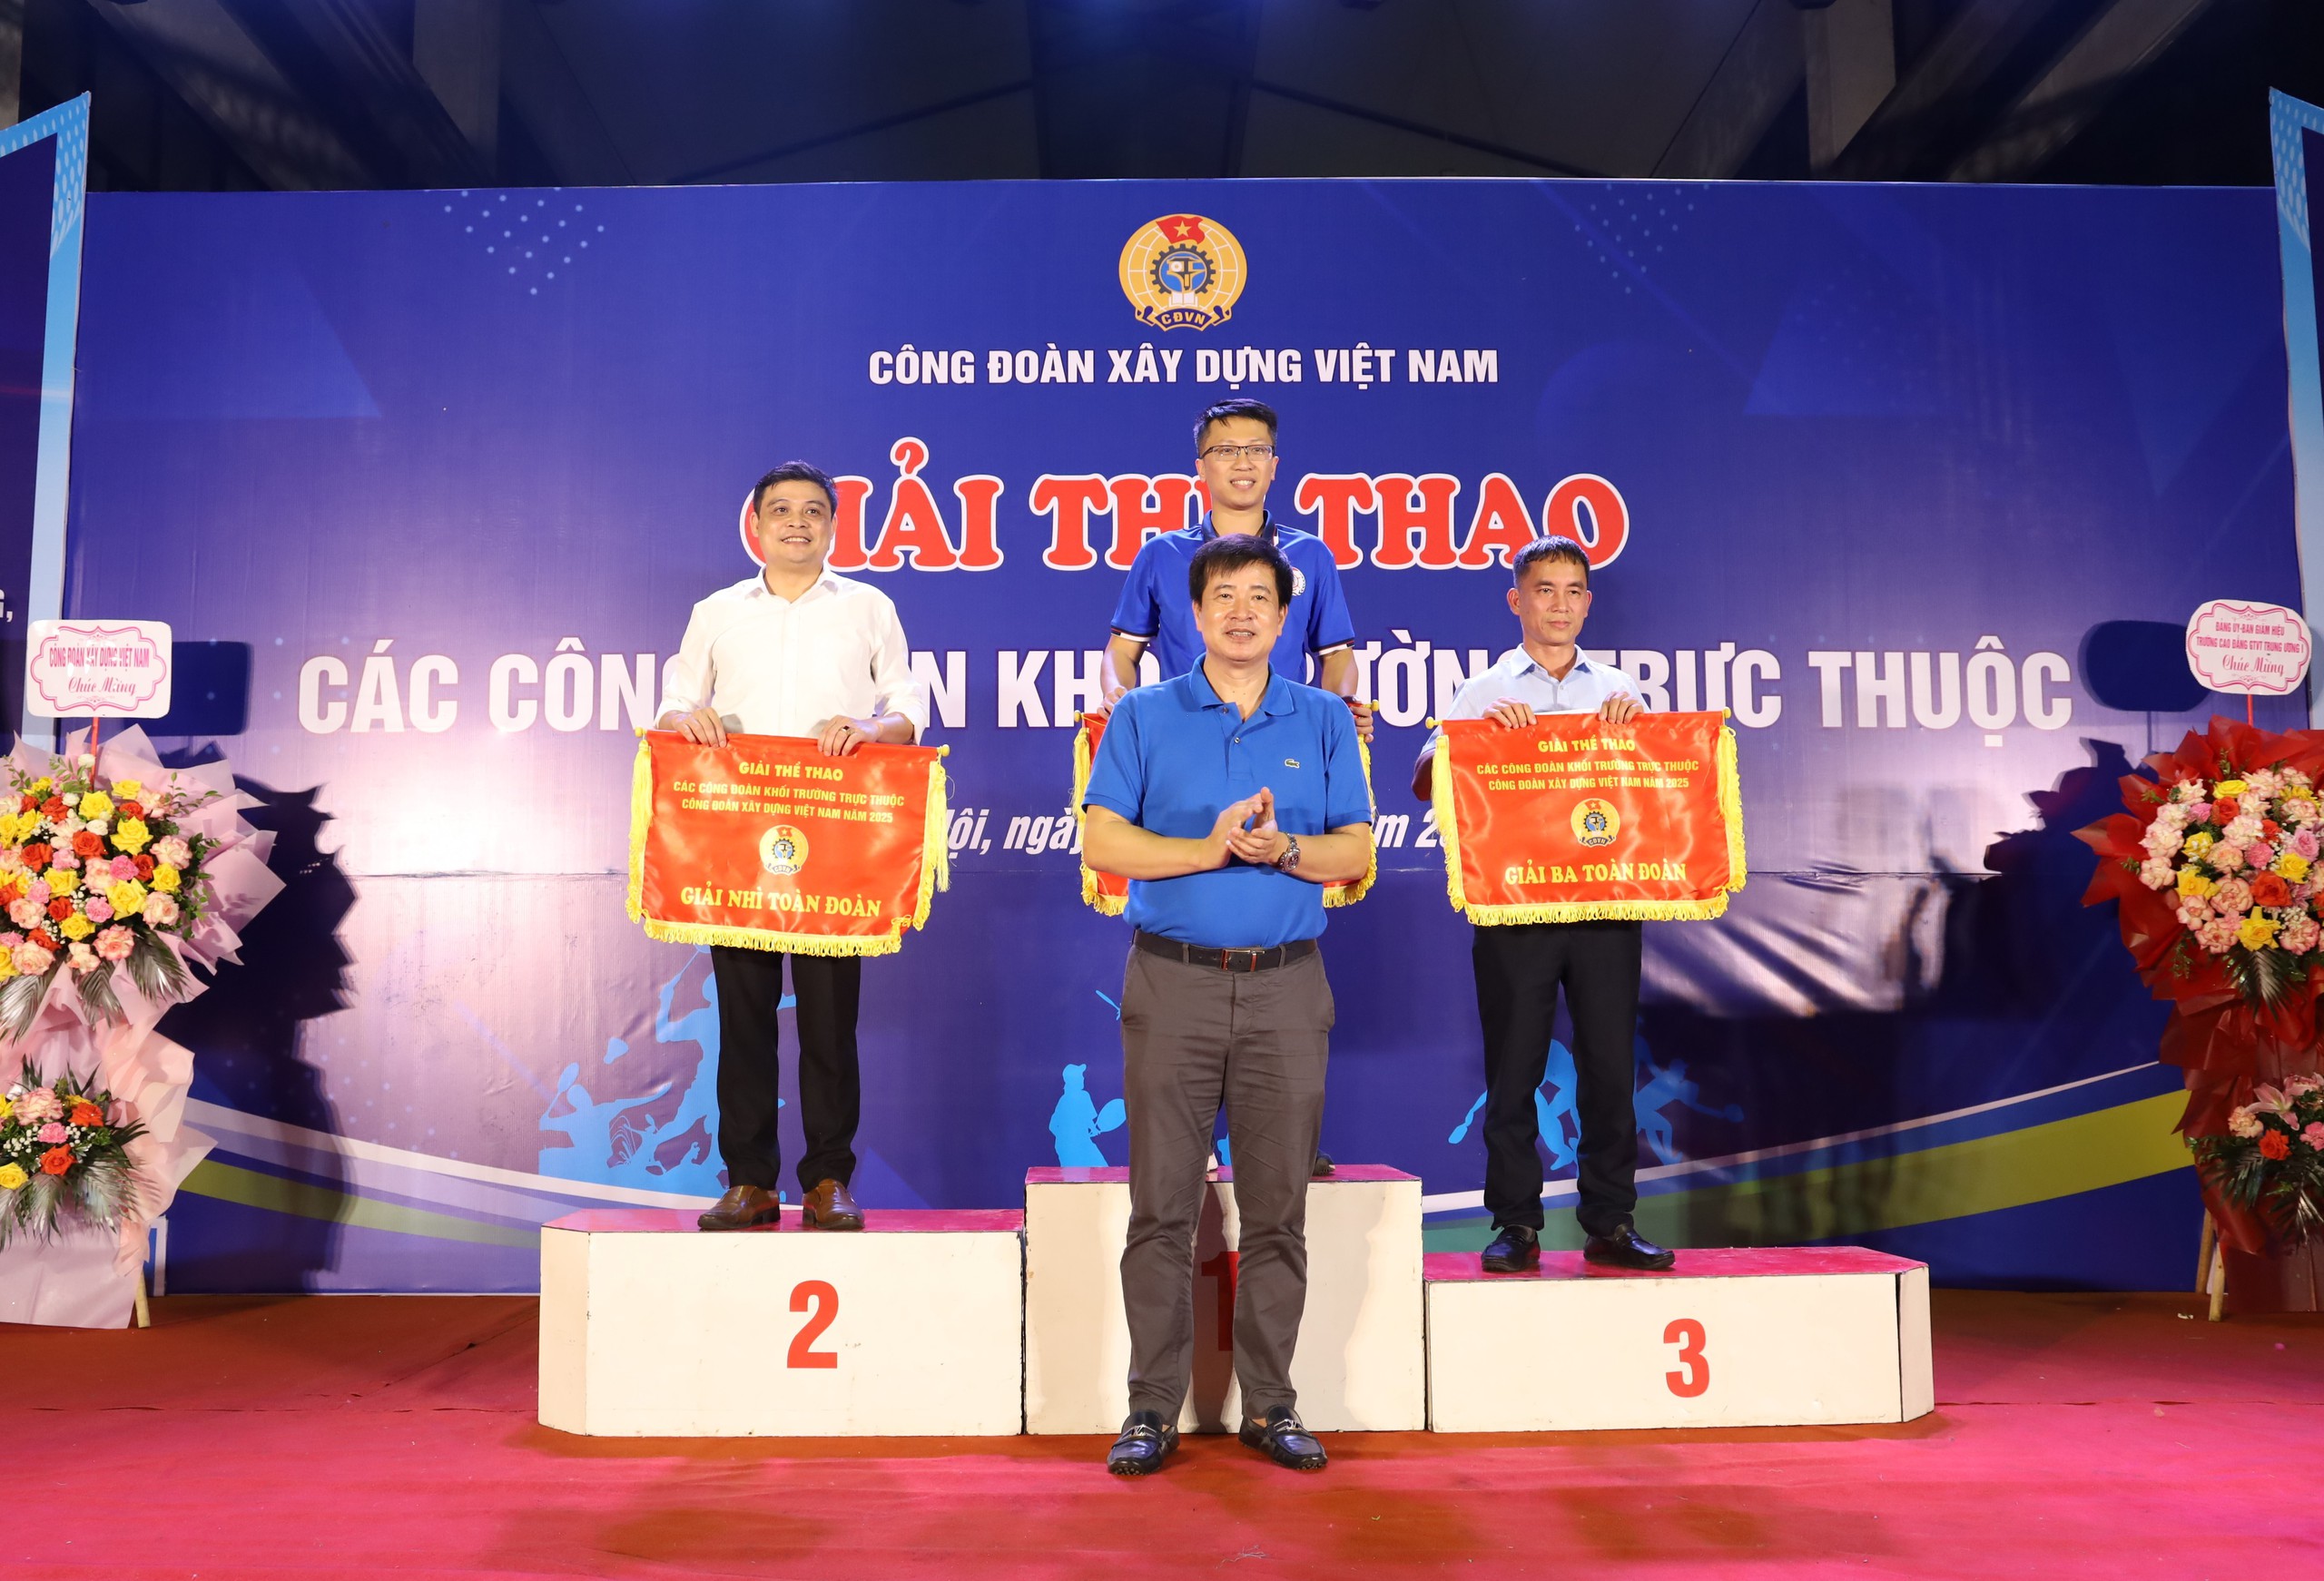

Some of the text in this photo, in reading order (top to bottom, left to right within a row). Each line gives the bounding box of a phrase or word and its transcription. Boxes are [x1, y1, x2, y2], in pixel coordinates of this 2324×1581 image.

[1161, 311, 1206, 325] CĐVN
[869, 342, 1498, 390] CÔNG ĐOÀN XÂY DỰNG VIỆT NAM
[1029, 473, 1210, 571] TH
[1295, 472, 1630, 571] THAO
[49, 643, 66, 667] CÔNG
[133, 647, 150, 667] NAM
[2220, 638, 2230, 648] CAO
[2250, 640, 2263, 651] GTVT
[2264, 641, 2282, 652] TRUNG
[2222, 654, 2249, 672] Chúc
[68, 677, 96, 692] Chúc
[298, 639, 458, 734] CÁC
[489, 637, 679, 732] CÔN
[1808, 635, 2072, 747] THUỘC
[1538, 734, 1635, 752] GIẢI THỂ THAO
[739, 761, 843, 781] GIẢI THỂ THAO
[1477, 757, 1699, 775] CÁC CÔNG ĐOÀN KHỐI TRƯỜNG TRỰC THUỘC
[1489, 773, 1689, 790] CÔNG ĐOÀN XÂY DỰNG VIỆT NAM NĂM 2025
[673, 781, 904, 808] CÁC CÔNG ĐOÀN KHỐI TRƯỜNG TRỰC THUỘC
[682, 798, 893, 823] CÔNG ĐOÀN XÂY DỰNG VIỆT NAM NĂM 2025
[947, 808, 991, 859] ội,
[1505, 859, 1687, 885] GIẢI BA TOÀN ĐOÀN
[681, 880, 881, 918] GIẢI NHÌ TOÀN ĐOÀN
[1201, 1251, 1240, 1350] 1
[787, 1280, 839, 1369] 2
[1663, 1318, 1709, 1398] 3
